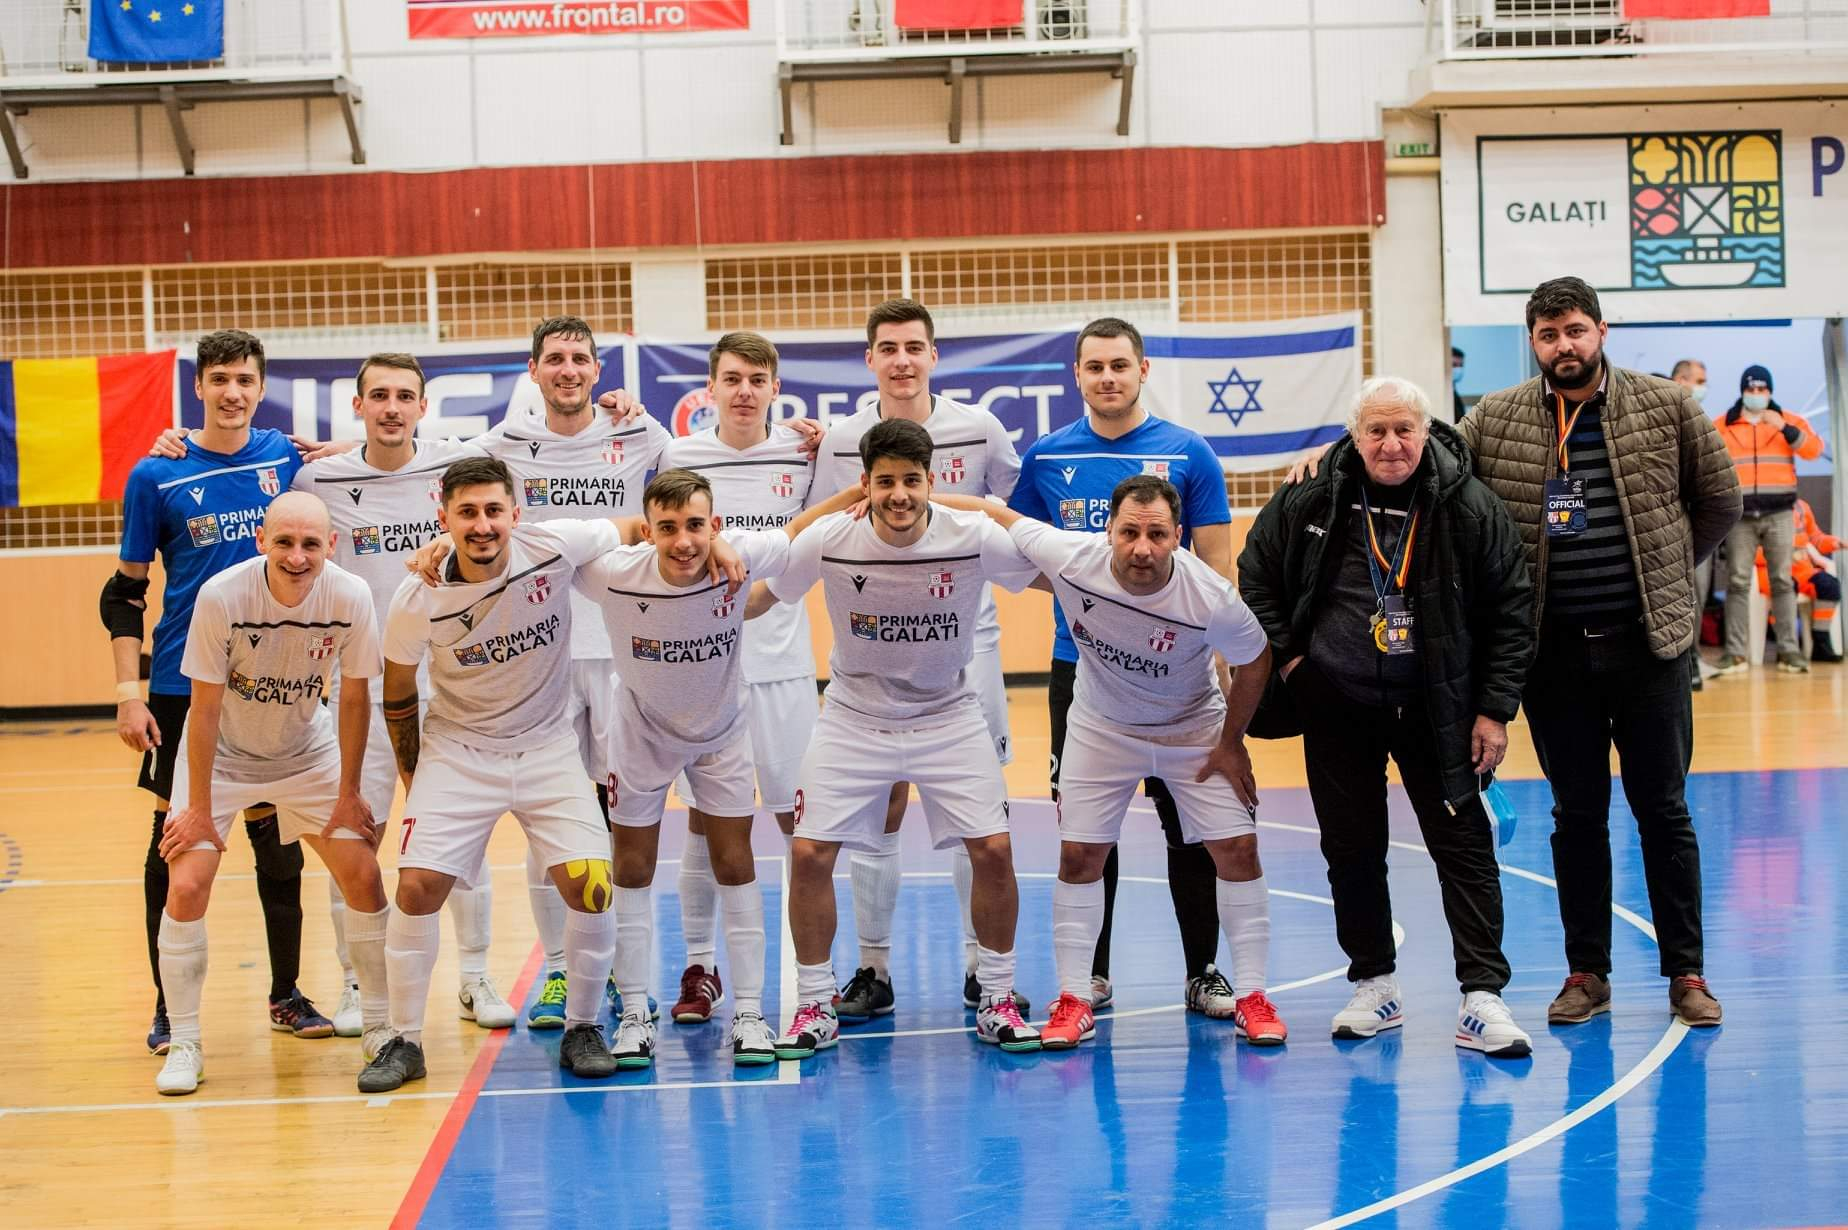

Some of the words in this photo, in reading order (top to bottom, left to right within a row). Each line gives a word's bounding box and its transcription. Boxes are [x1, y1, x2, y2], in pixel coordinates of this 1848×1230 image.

[473, 2, 685, 30] www.frontal.ro
[1400, 143, 1429, 155] EXIT
[1506, 200, 1606, 228] GALAȚI
[1549, 499, 1585, 509] OFFICIAL
[222, 520, 257, 542] GAL
[1392, 616, 1415, 626] STAFF
[607, 771, 619, 809] 8
[794, 788, 805, 825] 9
[400, 817, 417, 856] 7
